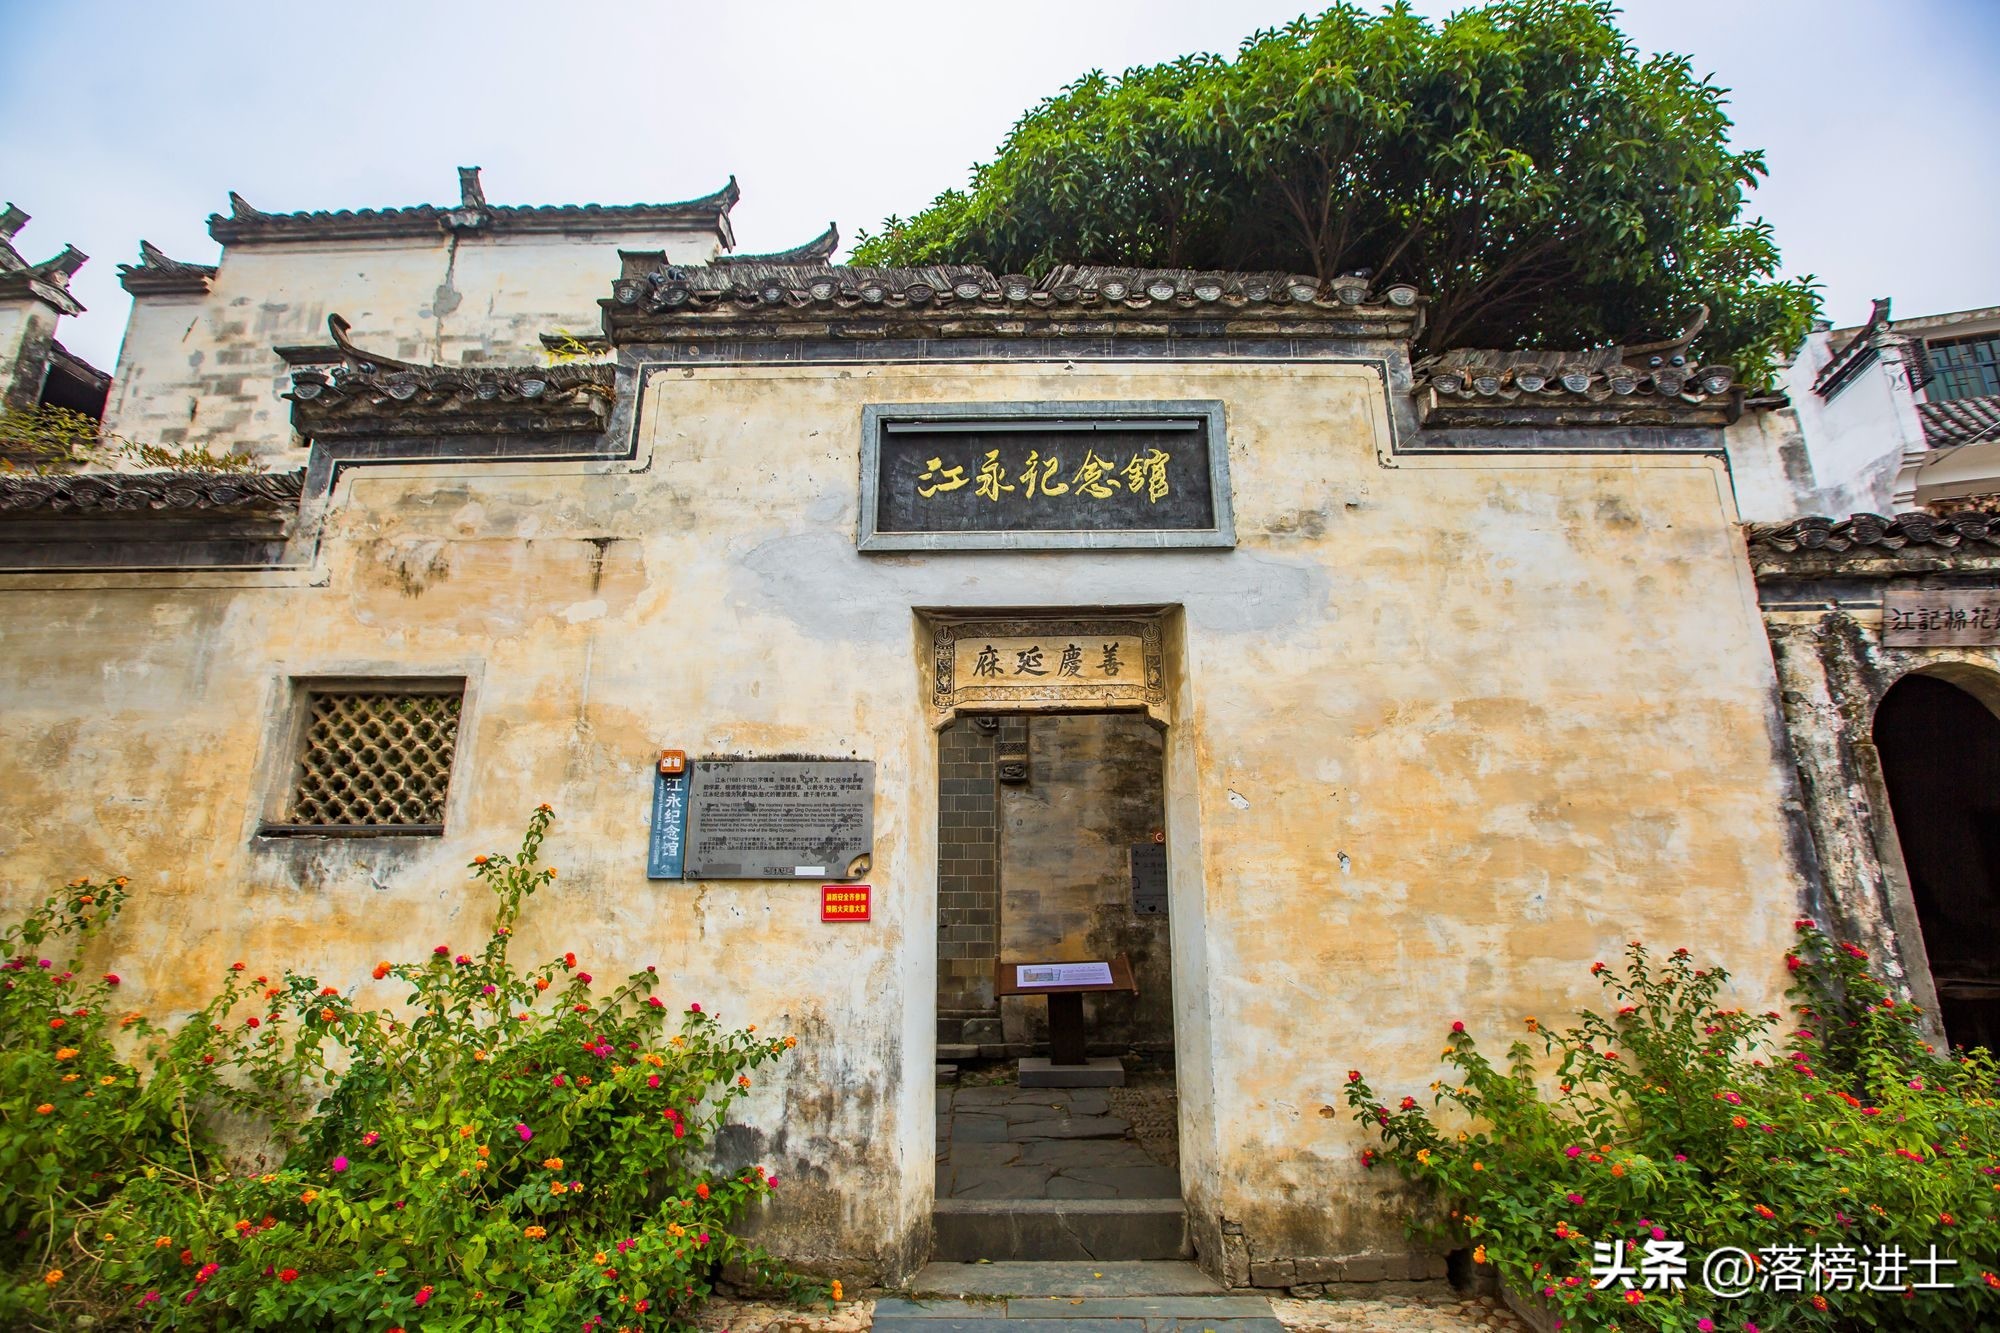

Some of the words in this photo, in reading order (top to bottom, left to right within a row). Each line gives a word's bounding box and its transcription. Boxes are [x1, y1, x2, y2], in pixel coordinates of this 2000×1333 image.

[662, 778, 683, 857] 江永纪念馆
